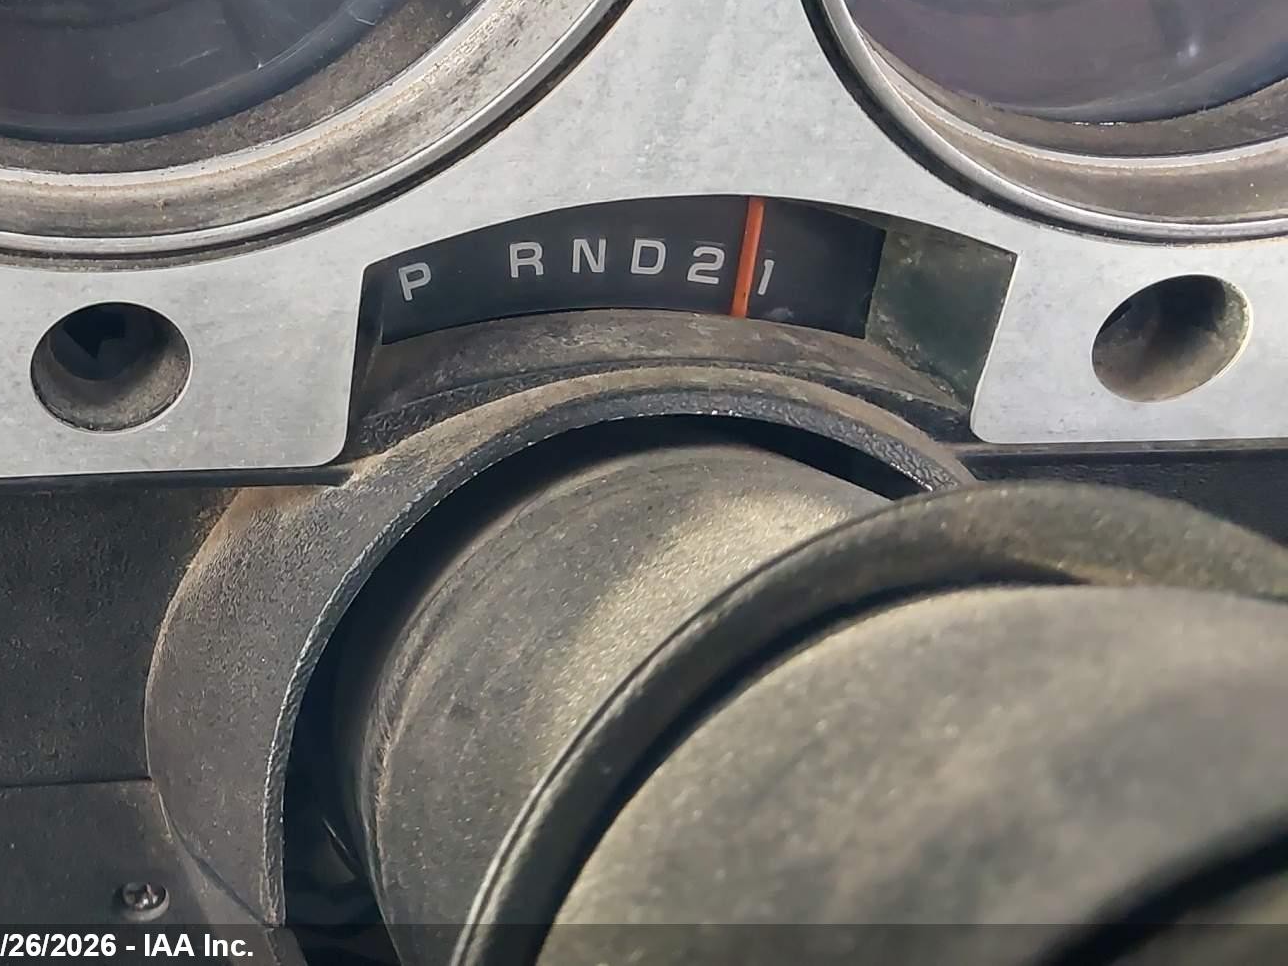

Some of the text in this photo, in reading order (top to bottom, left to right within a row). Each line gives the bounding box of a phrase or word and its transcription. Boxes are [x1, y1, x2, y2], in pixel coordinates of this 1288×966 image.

[397, 237, 776, 301] P R N D 2 1
